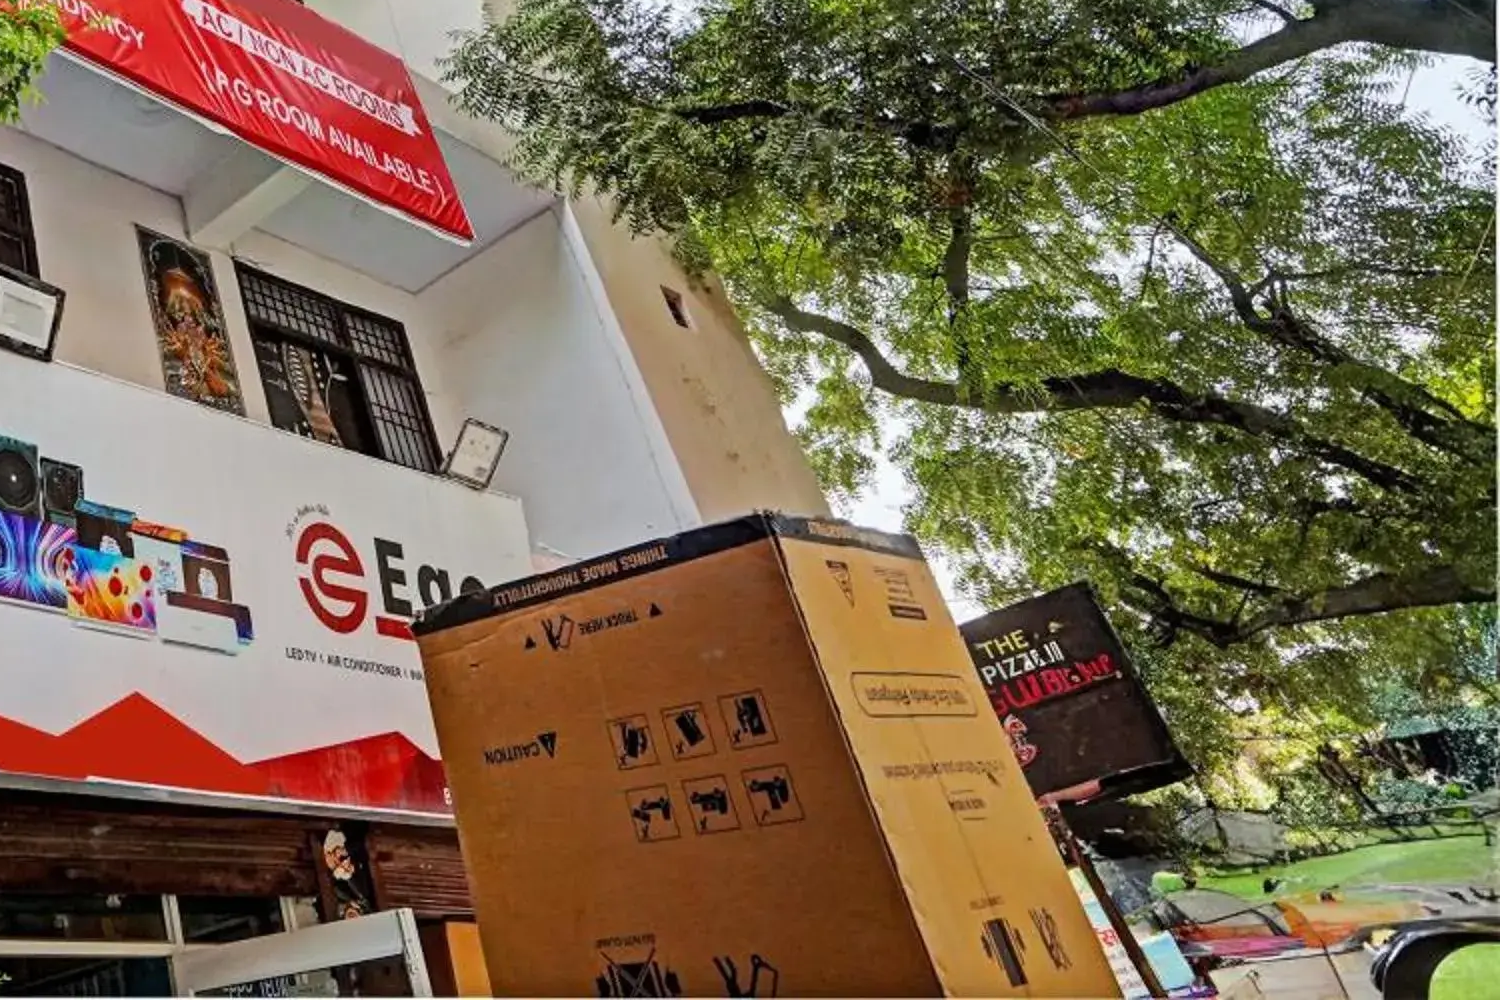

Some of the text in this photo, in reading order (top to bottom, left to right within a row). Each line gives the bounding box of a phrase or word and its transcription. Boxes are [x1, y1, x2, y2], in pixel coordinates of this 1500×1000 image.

[202, 5, 232, 38] AC
[249, 29, 297, 74] NON
[302, 61, 329, 89] AC
[333, 74, 405, 128] ROOMS
[254, 91, 325, 141] ROOM
[581, 560, 619, 583] MADE
[619, 544, 668, 571] THINGS
[977, 629, 1029, 660] THE
[484, 741, 540, 764] CAUTION
